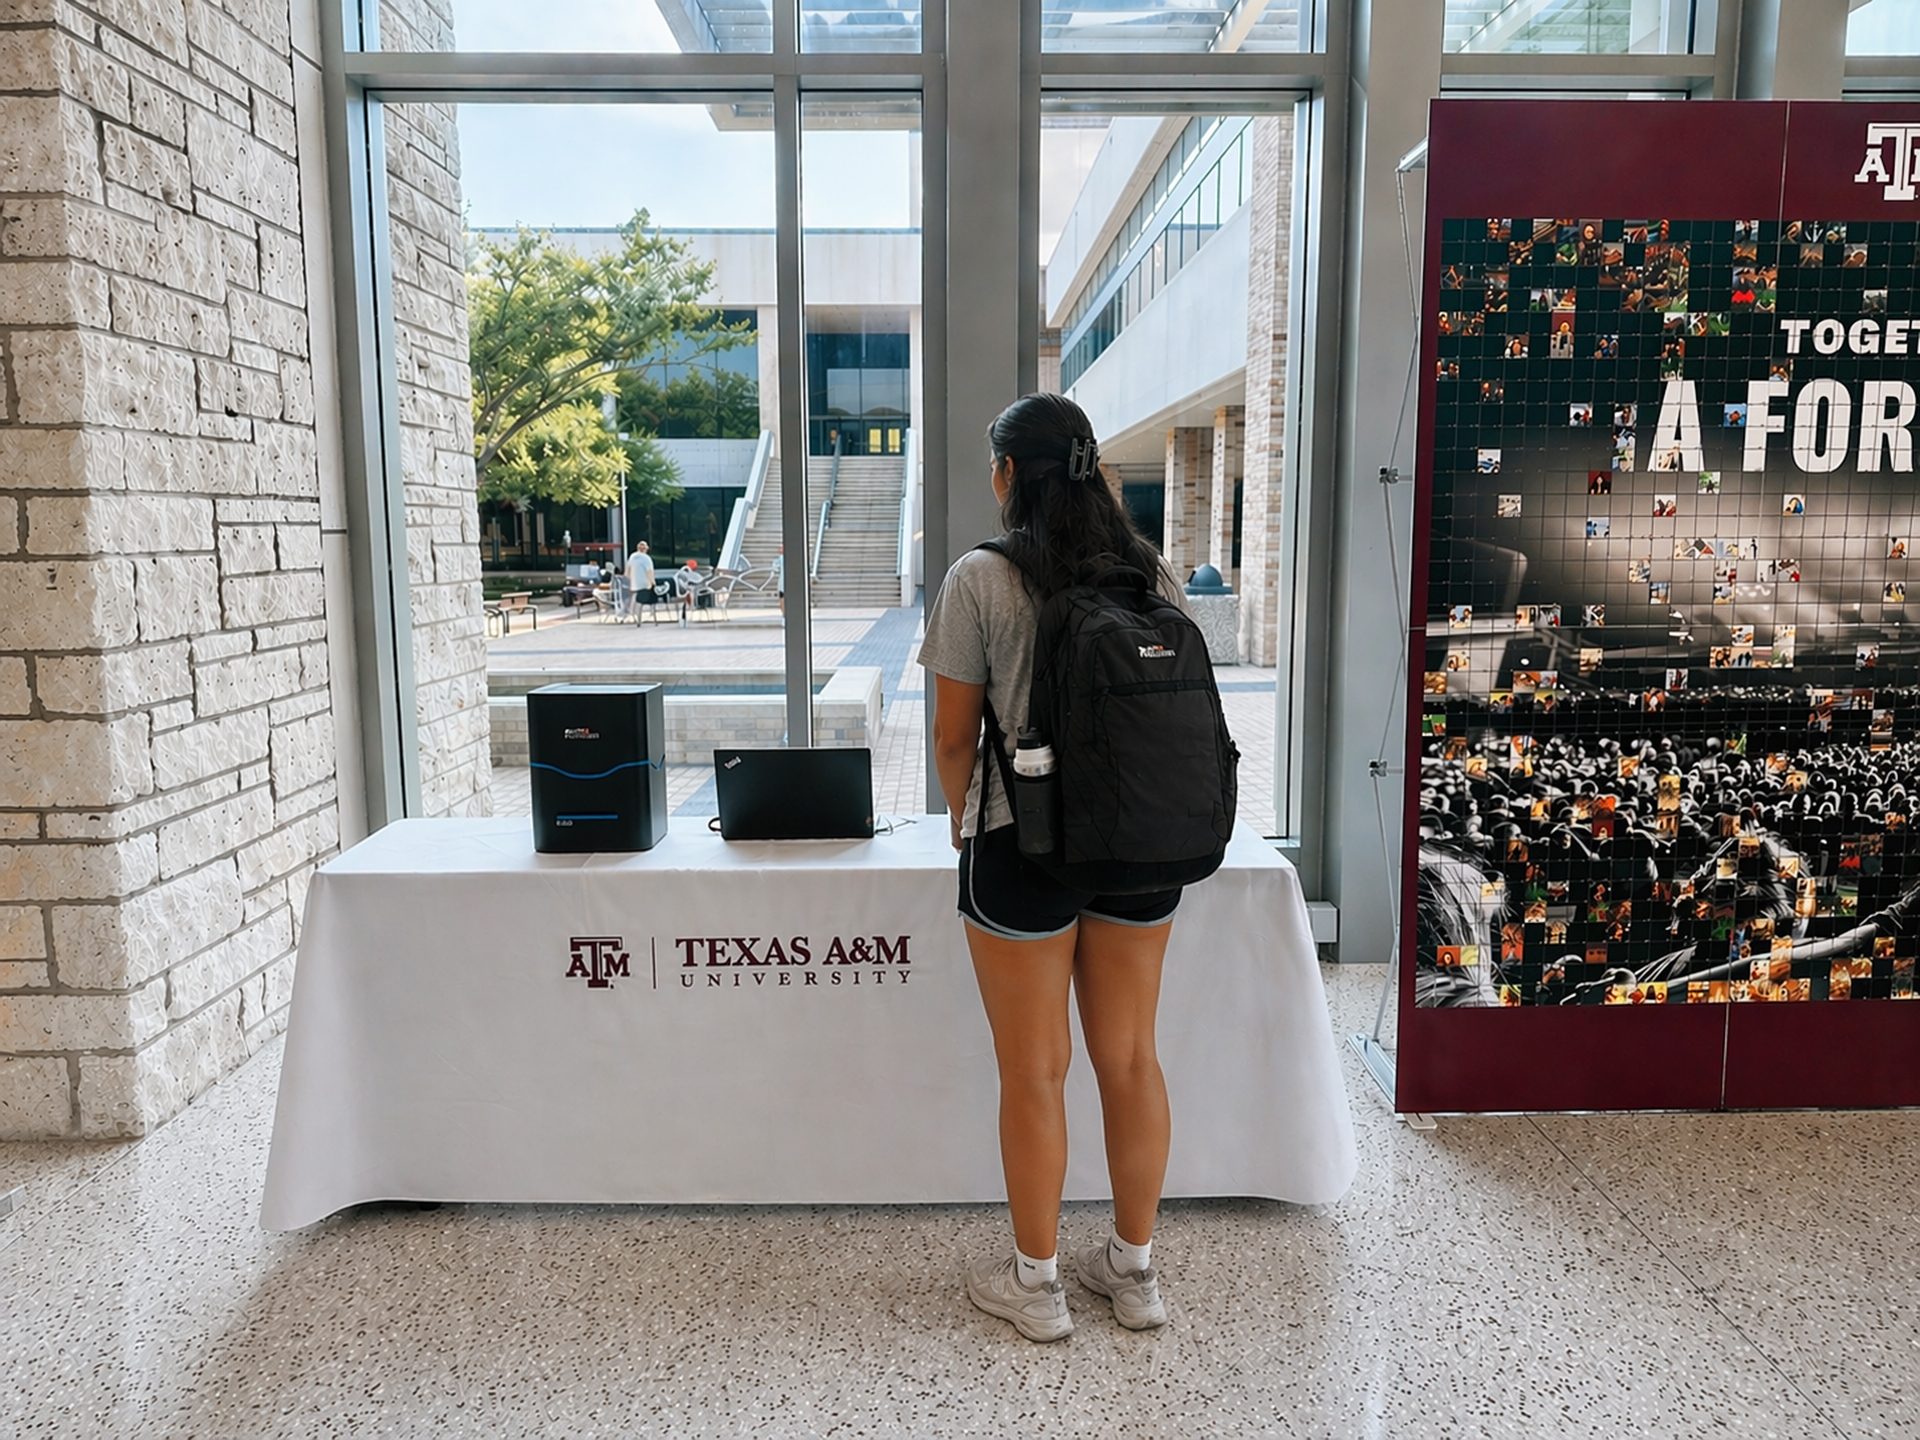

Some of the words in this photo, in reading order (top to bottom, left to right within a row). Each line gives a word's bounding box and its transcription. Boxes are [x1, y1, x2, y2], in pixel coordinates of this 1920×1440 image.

[1647, 380, 1705, 473] A
[1742, 378, 1917, 473] FOR
[675, 936, 811, 967] TEXAS
[823, 935, 911, 965] A&M
[681, 970, 911, 988] UNIVERSITY
